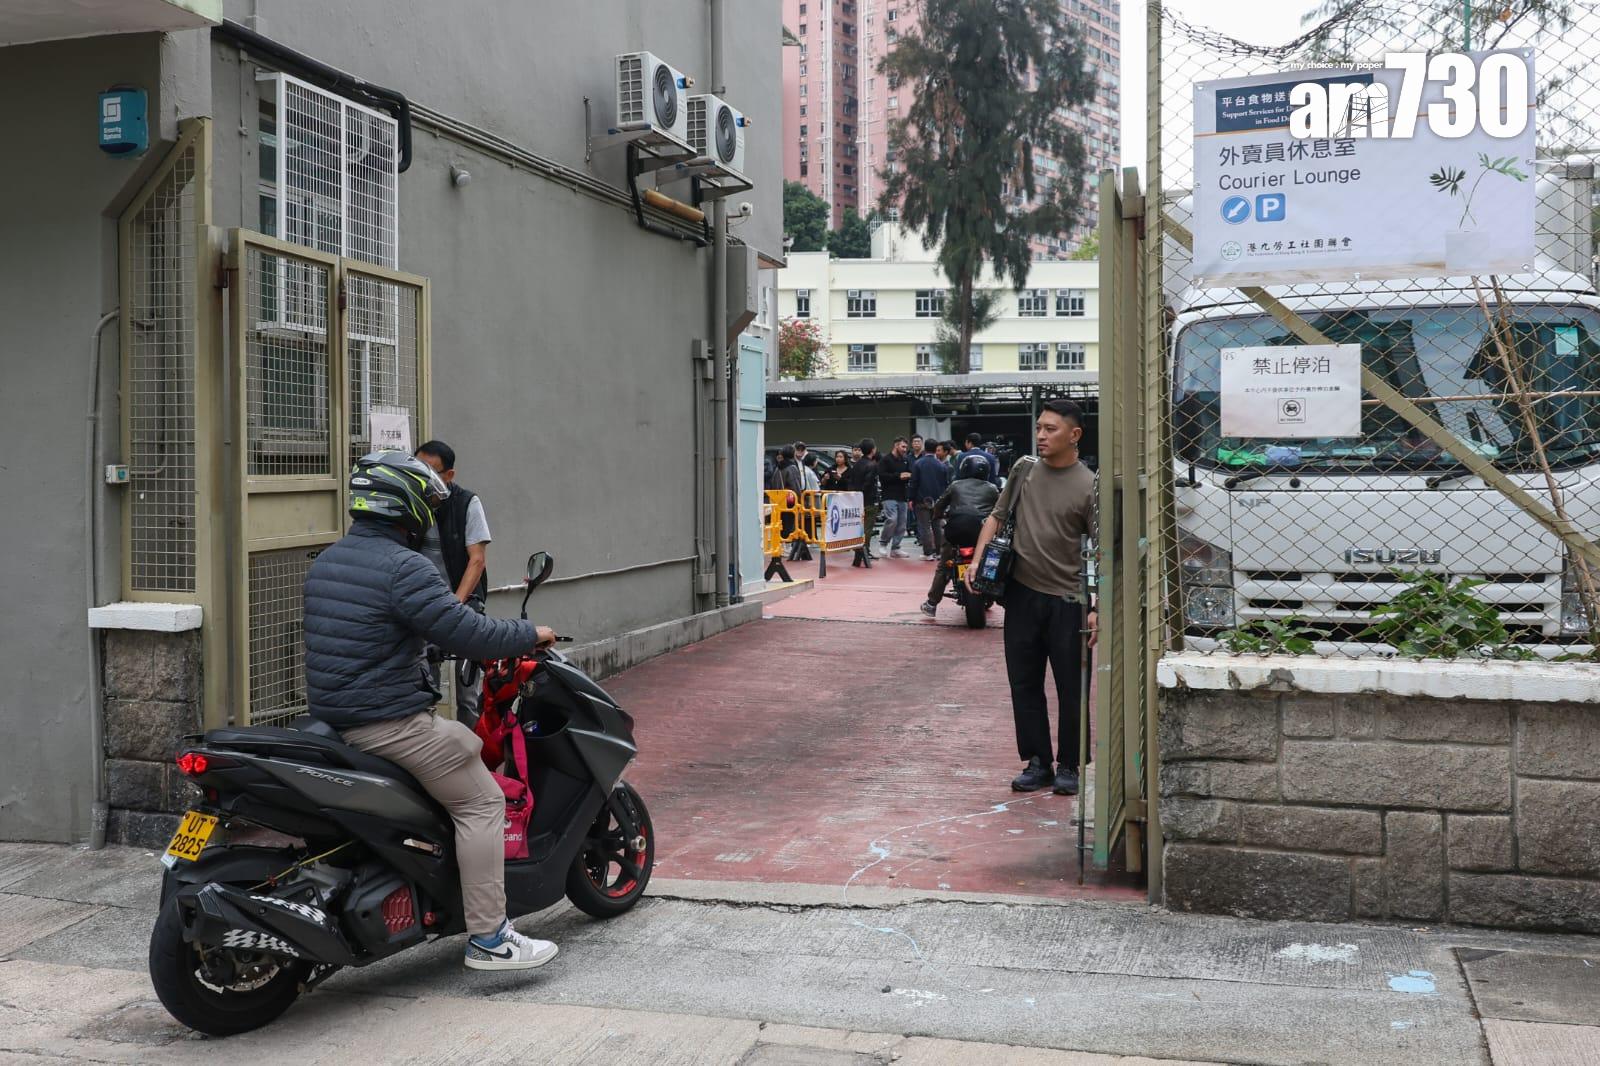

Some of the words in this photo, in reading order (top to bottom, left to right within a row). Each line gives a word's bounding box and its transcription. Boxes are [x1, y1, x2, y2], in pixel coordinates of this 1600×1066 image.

[1222, 91, 1291, 107] 平台食物送
[1222, 110, 1248, 119] Support
[1248, 107, 1274, 116] Services
[1263, 115, 1280, 124] Food
[1219, 138, 1357, 167] 外賣員休息室
[1219, 172, 1286, 190] Courier
[1294, 168, 1361, 185] Lounge
[1262, 197, 1280, 218] P
[1253, 356, 1331, 375] 禁止停泊
[1345, 548, 1441, 565] ISUZU
[187, 815, 208, 835] UT
[169, 832, 205, 856] 2825
